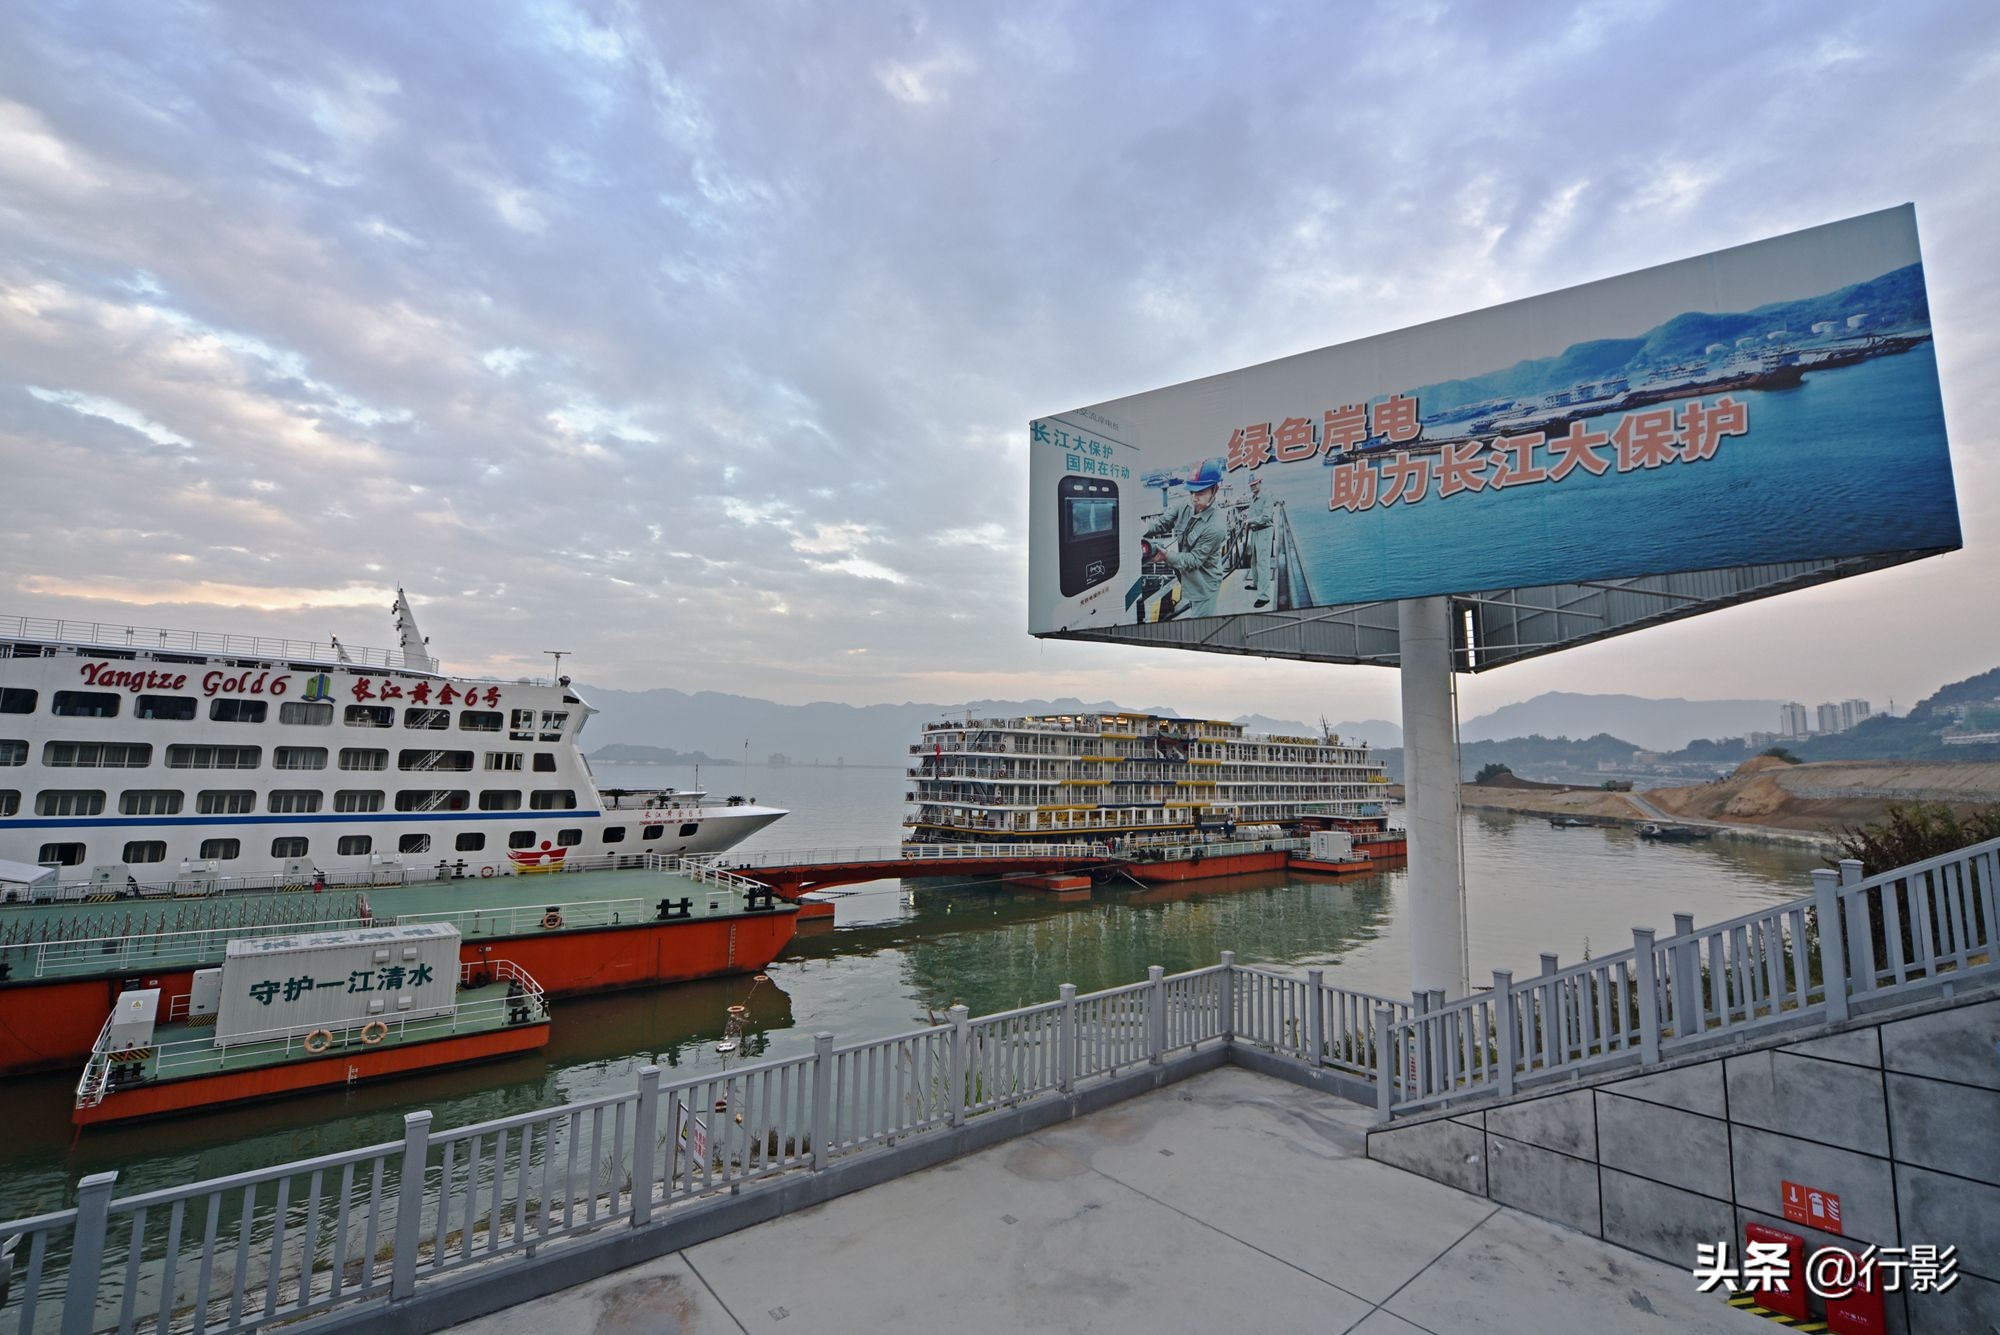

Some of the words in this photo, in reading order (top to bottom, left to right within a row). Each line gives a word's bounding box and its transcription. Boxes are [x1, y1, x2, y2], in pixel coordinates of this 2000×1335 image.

[1030, 421, 1114, 459] 长江大保护
[1226, 394, 1421, 473] 绿色岸电
[1066, 453, 1130, 479] 国网在行动
[1328, 397, 1749, 512] 助力长江大保护
[80, 661, 187, 693] Yangtze
[351, 677, 502, 708] 长江黄金6号
[249, 963, 433, 1006] 守护一江清水
